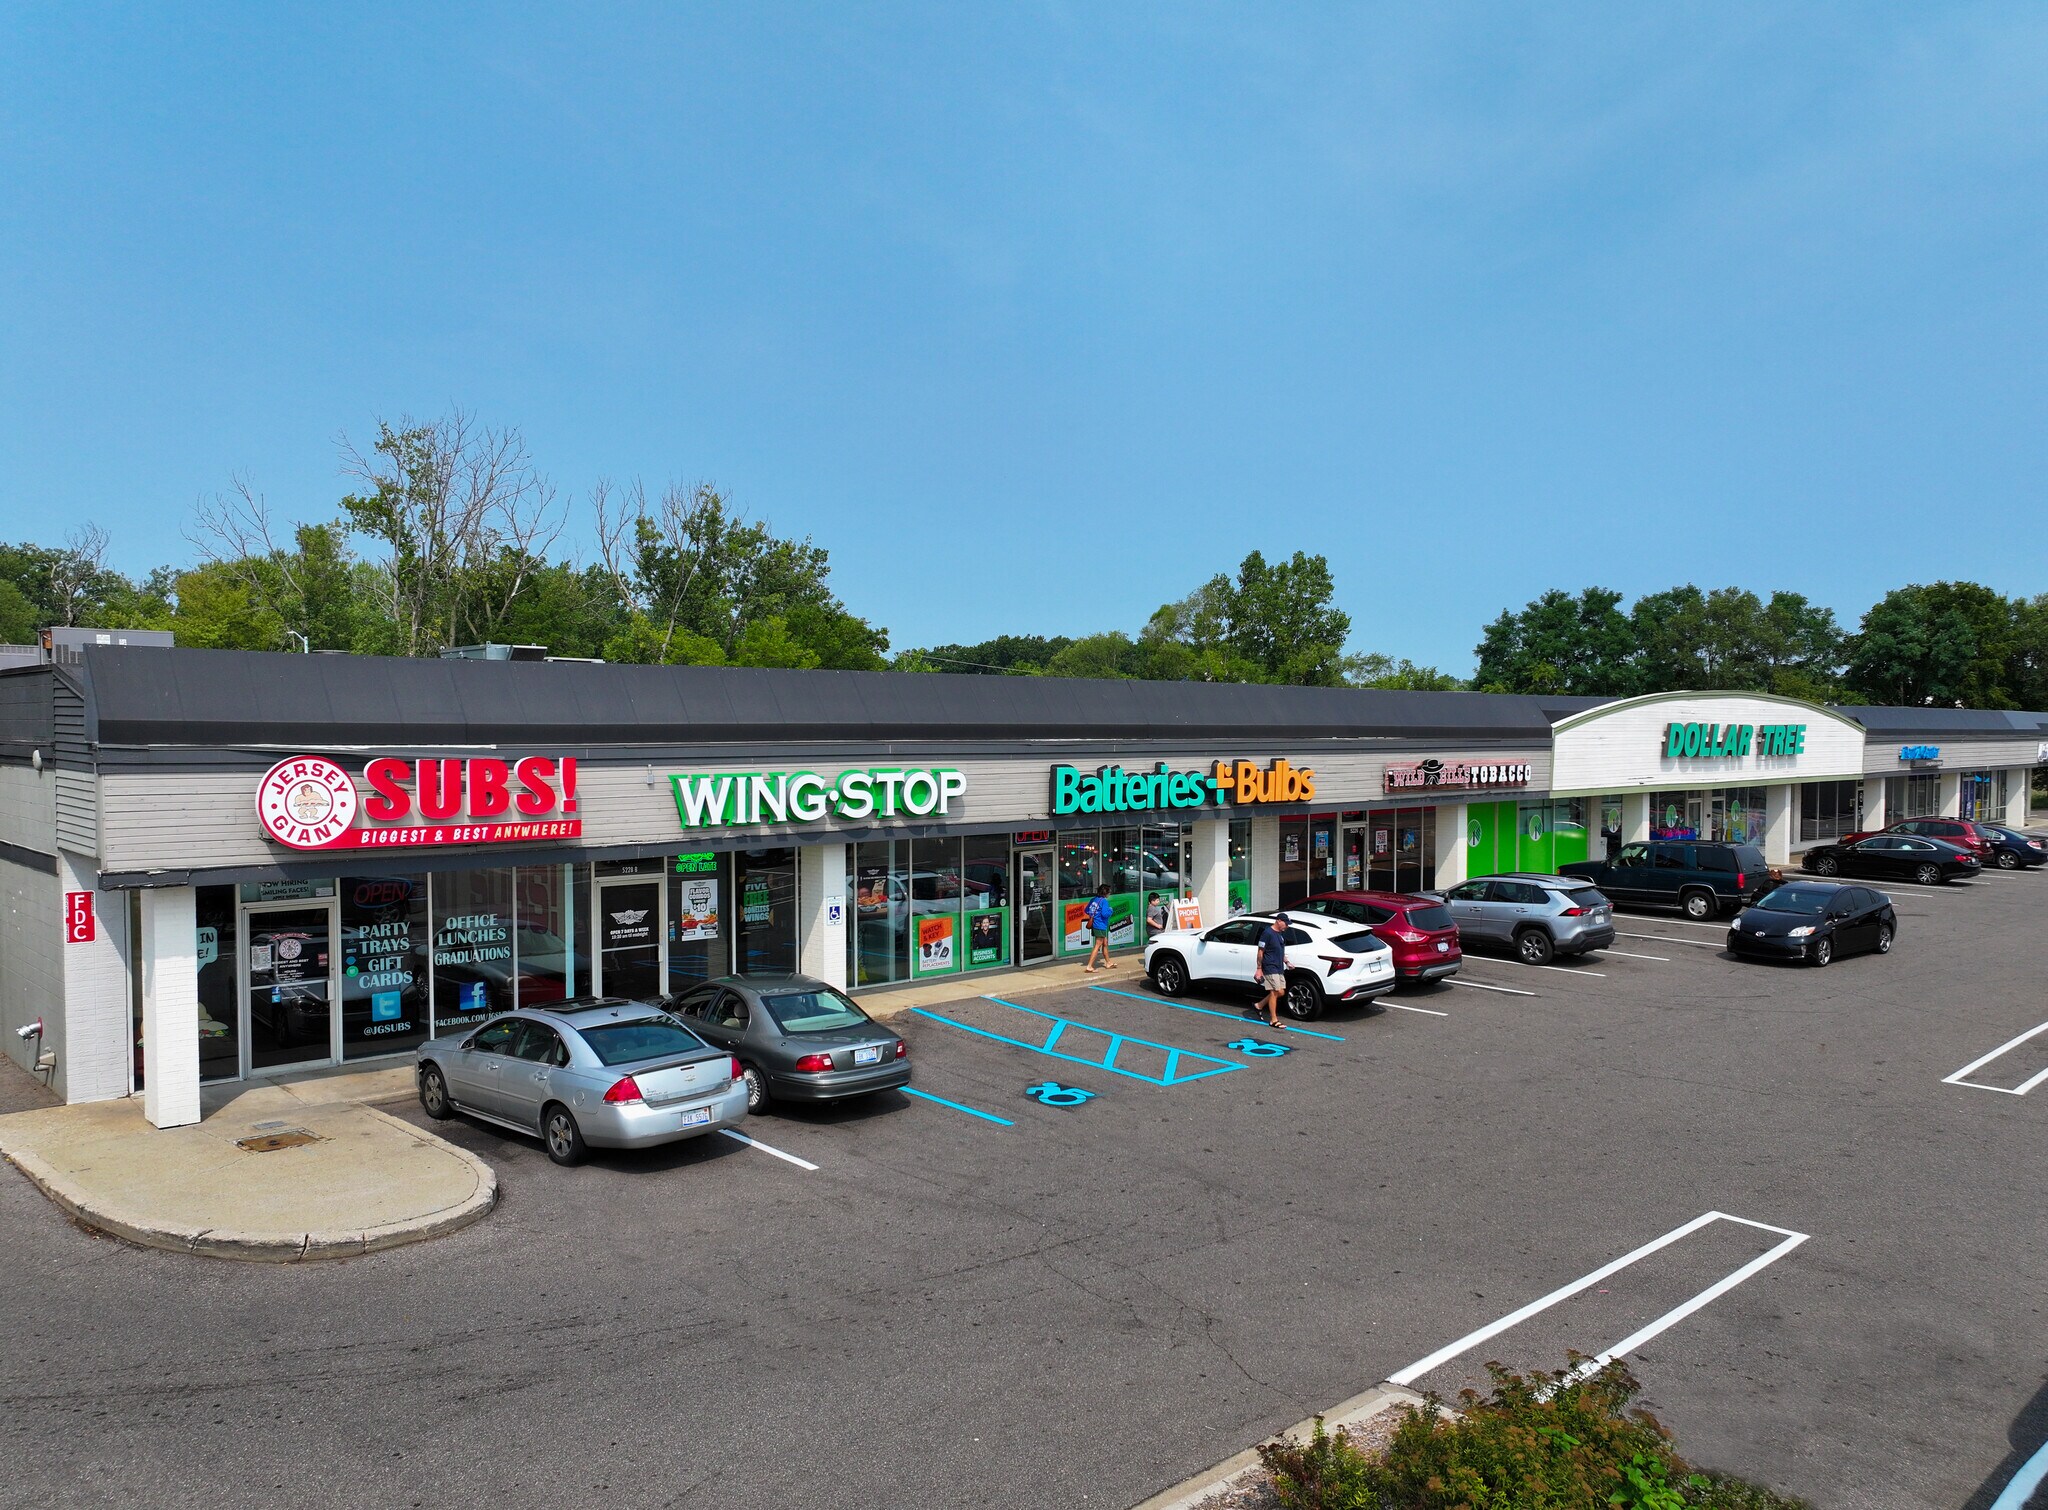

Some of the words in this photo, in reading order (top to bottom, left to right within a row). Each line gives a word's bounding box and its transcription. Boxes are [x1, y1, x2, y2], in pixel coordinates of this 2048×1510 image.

[1667, 722, 1754, 758] DOLLAR
[1762, 724, 1807, 756] TREE
[267, 763, 349, 795] JERSEY
[1393, 769, 1425, 787] WILD
[1471, 764, 1532, 784] TOBACCO
[363, 756, 577, 821] SUBS!
[270, 813, 348, 844] GIANT
[361, 828, 427, 844] BIGGEST
[434, 828, 444, 842] &
[453, 826, 488, 841] BEST
[493, 822, 574, 839] ANYWHERE!
[675, 862, 697, 873] OPEN
[698, 861, 718, 872] LATE
[281, 879, 309, 887] HIRING
[288, 886, 310, 895] FACES!
[745, 882, 768, 891] FIVE
[353, 881, 407, 904] OPEN
[744, 891, 769, 906] FREE
[73, 894, 87, 940] FDC
[744, 904, 770, 914] BONELESS
[1179, 908, 1199, 917] PHONE
[446, 913, 499, 930] OFFICE
[744, 913, 770, 922] WINGS
[359, 921, 410, 939] PARTY
[438, 927, 507, 946] LUNCHES
[922, 923, 943, 935] WATCH
[928, 930, 940, 940] KEY
[200, 932, 215, 944] IN
[359, 936, 410, 955] TRAYS
[434, 945, 511, 966] GRADUATIONS
[973, 949, 993, 957] BUSINESS
[367, 956, 404, 972] GIFT
[922, 960, 950, 968] REPLACEMENTS
[359, 970, 414, 989] CARDS
[363, 1021, 411, 1036] @JGSUBS
